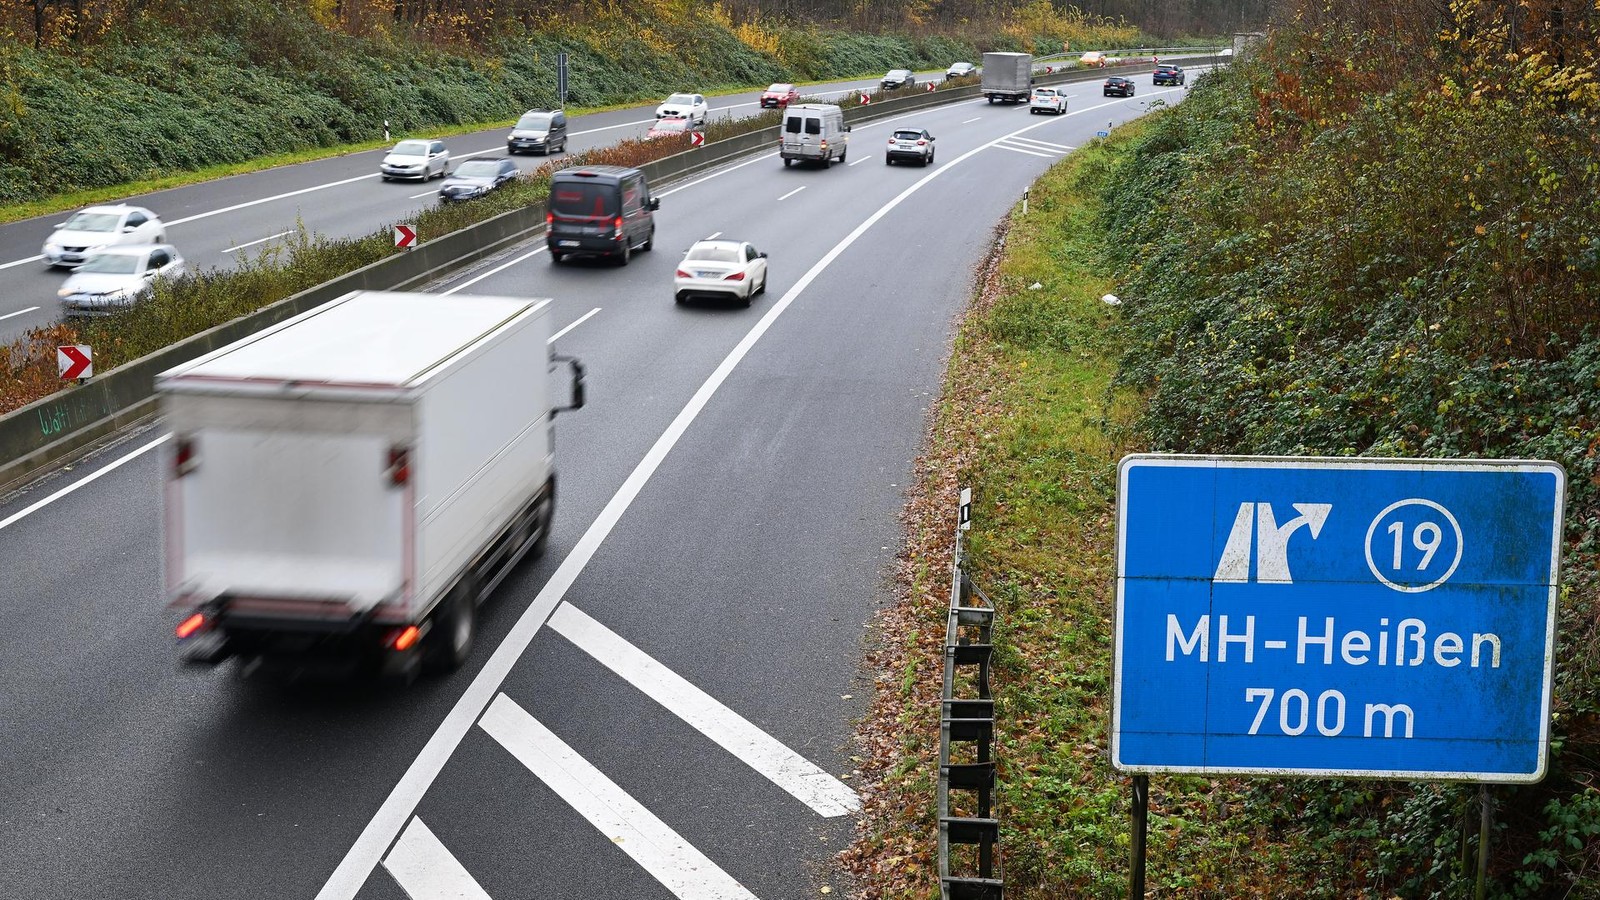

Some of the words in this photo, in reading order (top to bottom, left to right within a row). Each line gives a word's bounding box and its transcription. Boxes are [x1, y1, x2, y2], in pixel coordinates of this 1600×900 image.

[1388, 521, 1442, 570] 19
[1165, 613, 1502, 668] MH-Heißen
[1245, 688, 1346, 737] 700
[1363, 703, 1415, 739] m
